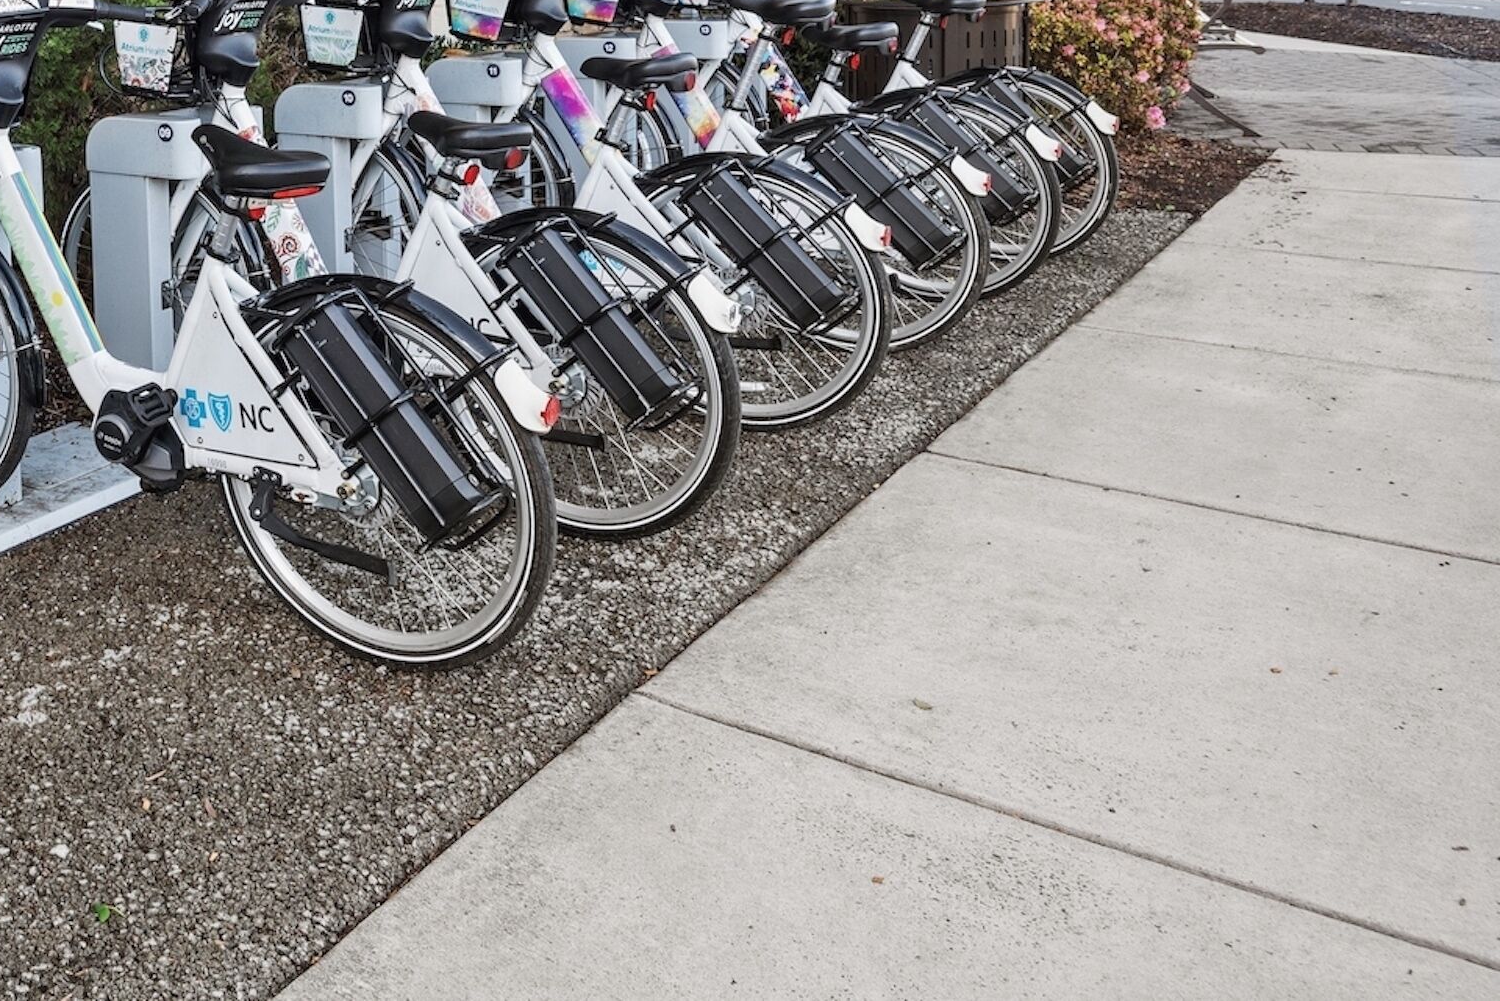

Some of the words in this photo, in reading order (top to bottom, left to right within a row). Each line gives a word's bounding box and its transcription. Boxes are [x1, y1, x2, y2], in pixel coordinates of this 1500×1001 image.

[213, 9, 244, 32] joy
[488, 66, 498, 76] 11
[343, 92, 355, 104] 10
[239, 402, 274, 433] NC
